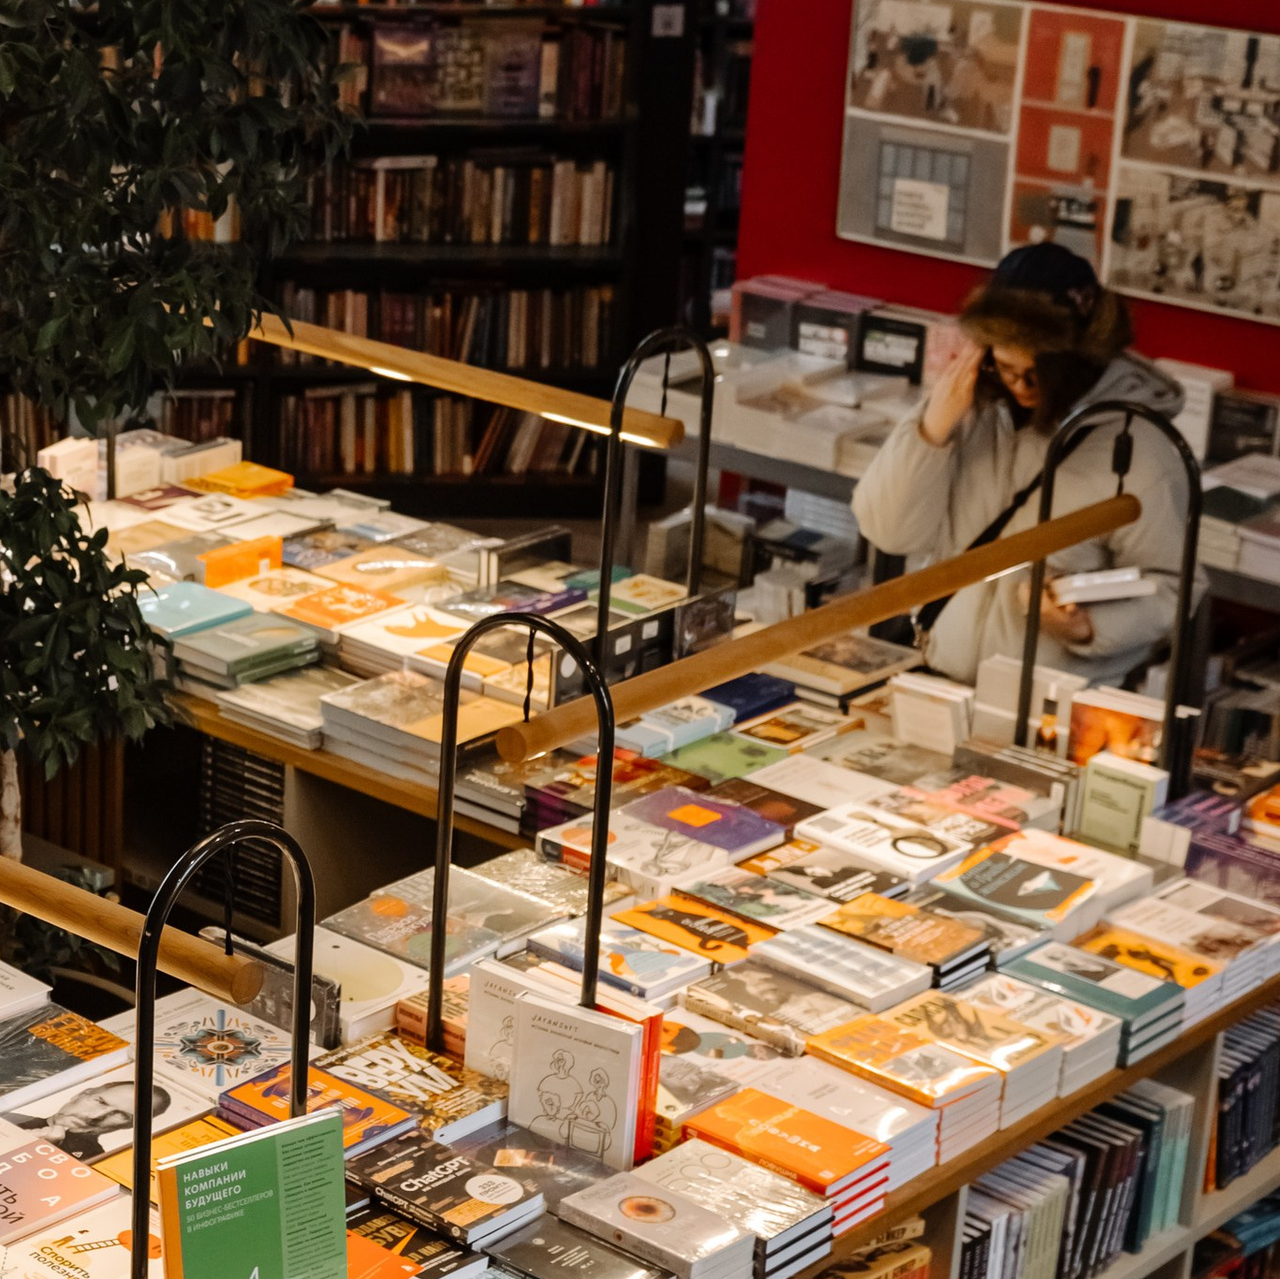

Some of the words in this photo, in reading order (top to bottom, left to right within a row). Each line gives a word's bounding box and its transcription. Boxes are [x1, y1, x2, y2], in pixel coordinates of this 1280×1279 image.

[183, 1161, 229, 1183] НАВЫКИ
[184, 1169, 247, 1196] КОМПАНИИ
[400, 1156, 471, 1193] ChatGPT
[185, 1185, 242, 1210] БУДУЩЕГО
[186, 1215, 196, 1223] 50
[196, 1189, 274, 1221] БИЗНЕС-БЕСТСЕЛЛЕРОВ
[375, 1186, 411, 1210] ChatGPT
[192, 1209, 245, 1232] ИНФОГРАФИКЕ
[39, 1246, 91, 1279] Спорить
